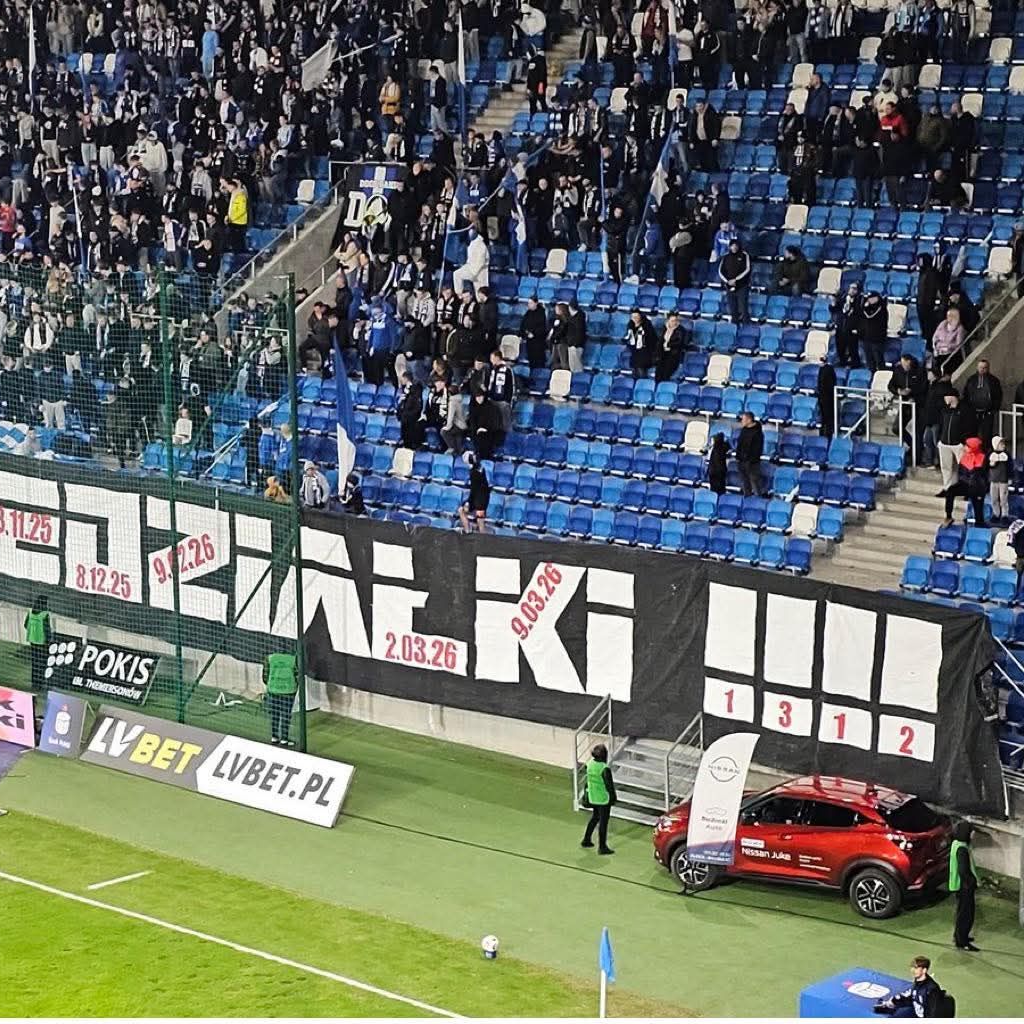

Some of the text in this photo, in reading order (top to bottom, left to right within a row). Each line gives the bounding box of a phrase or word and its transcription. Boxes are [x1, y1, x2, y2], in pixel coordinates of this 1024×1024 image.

[76, 564, 131, 598] 8.12.25
[511, 562, 562, 640] 9.03.26
[78, 644, 154, 685] POKIS
[385, 631, 458, 670] 2.03.26
[213, 750, 335, 807] LVBET.PL
